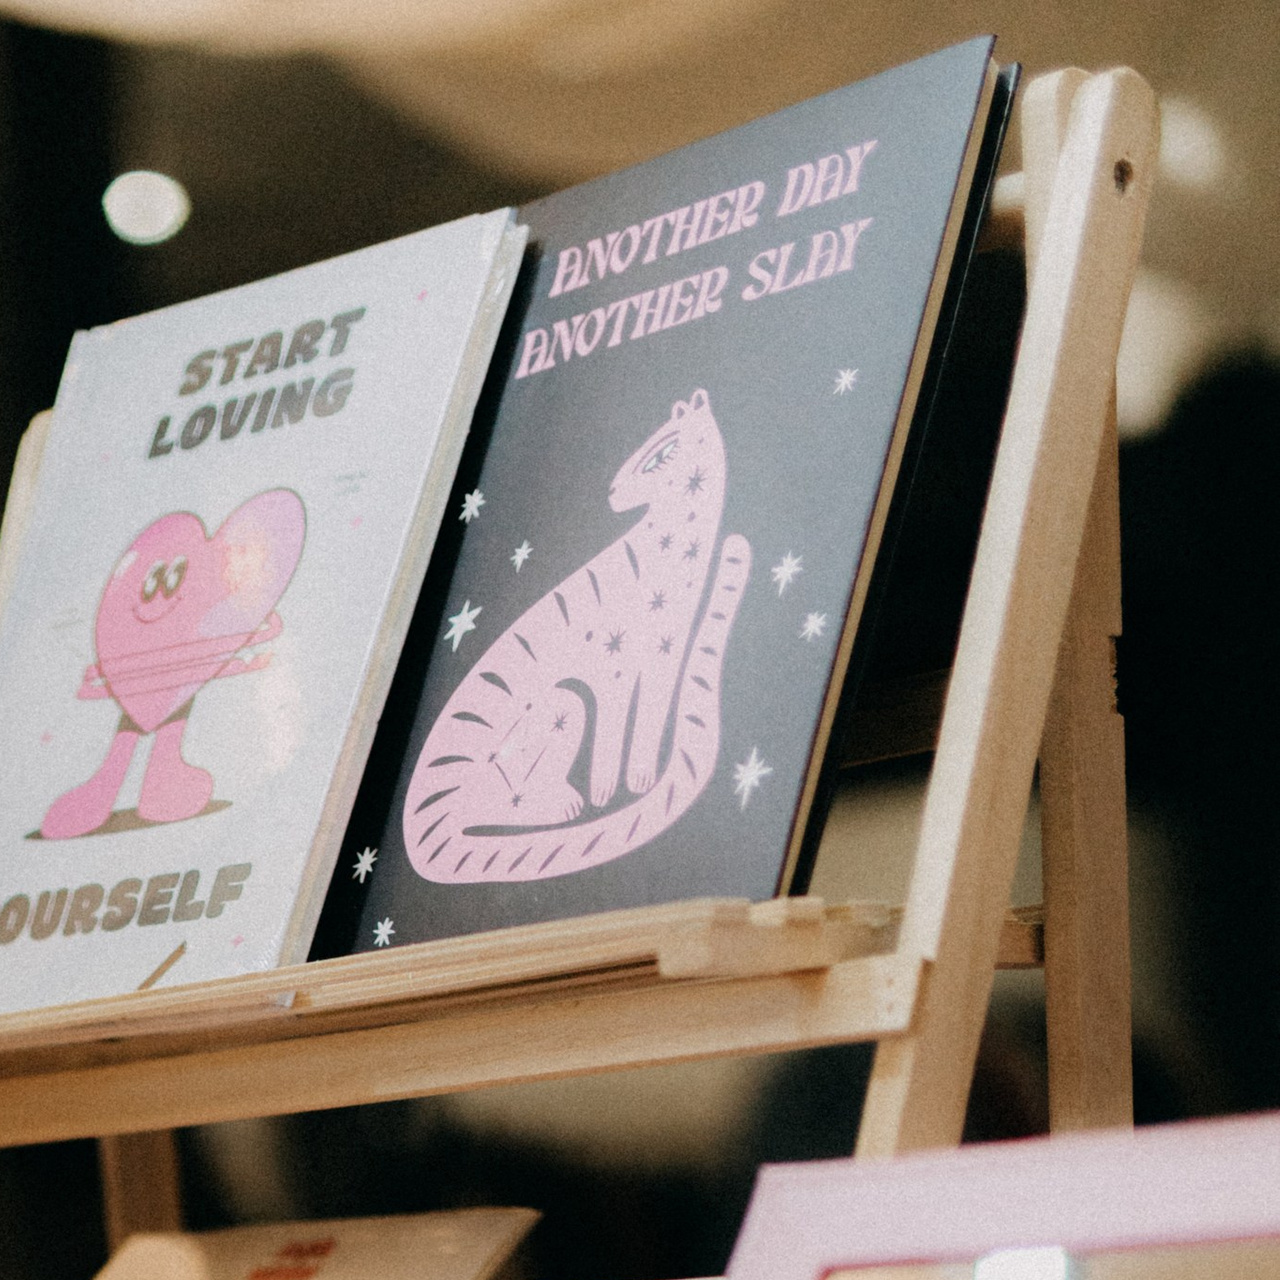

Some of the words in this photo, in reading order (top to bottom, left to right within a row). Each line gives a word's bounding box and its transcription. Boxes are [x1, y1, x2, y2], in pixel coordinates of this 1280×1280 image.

[549, 180, 766, 299] ANOTHER
[777, 140, 878, 218] DAY
[178, 307, 367, 398] START
[515, 265, 730, 379] ANOTHER
[741, 217, 874, 301] SLAY
[147, 367, 355, 460] LOVING
